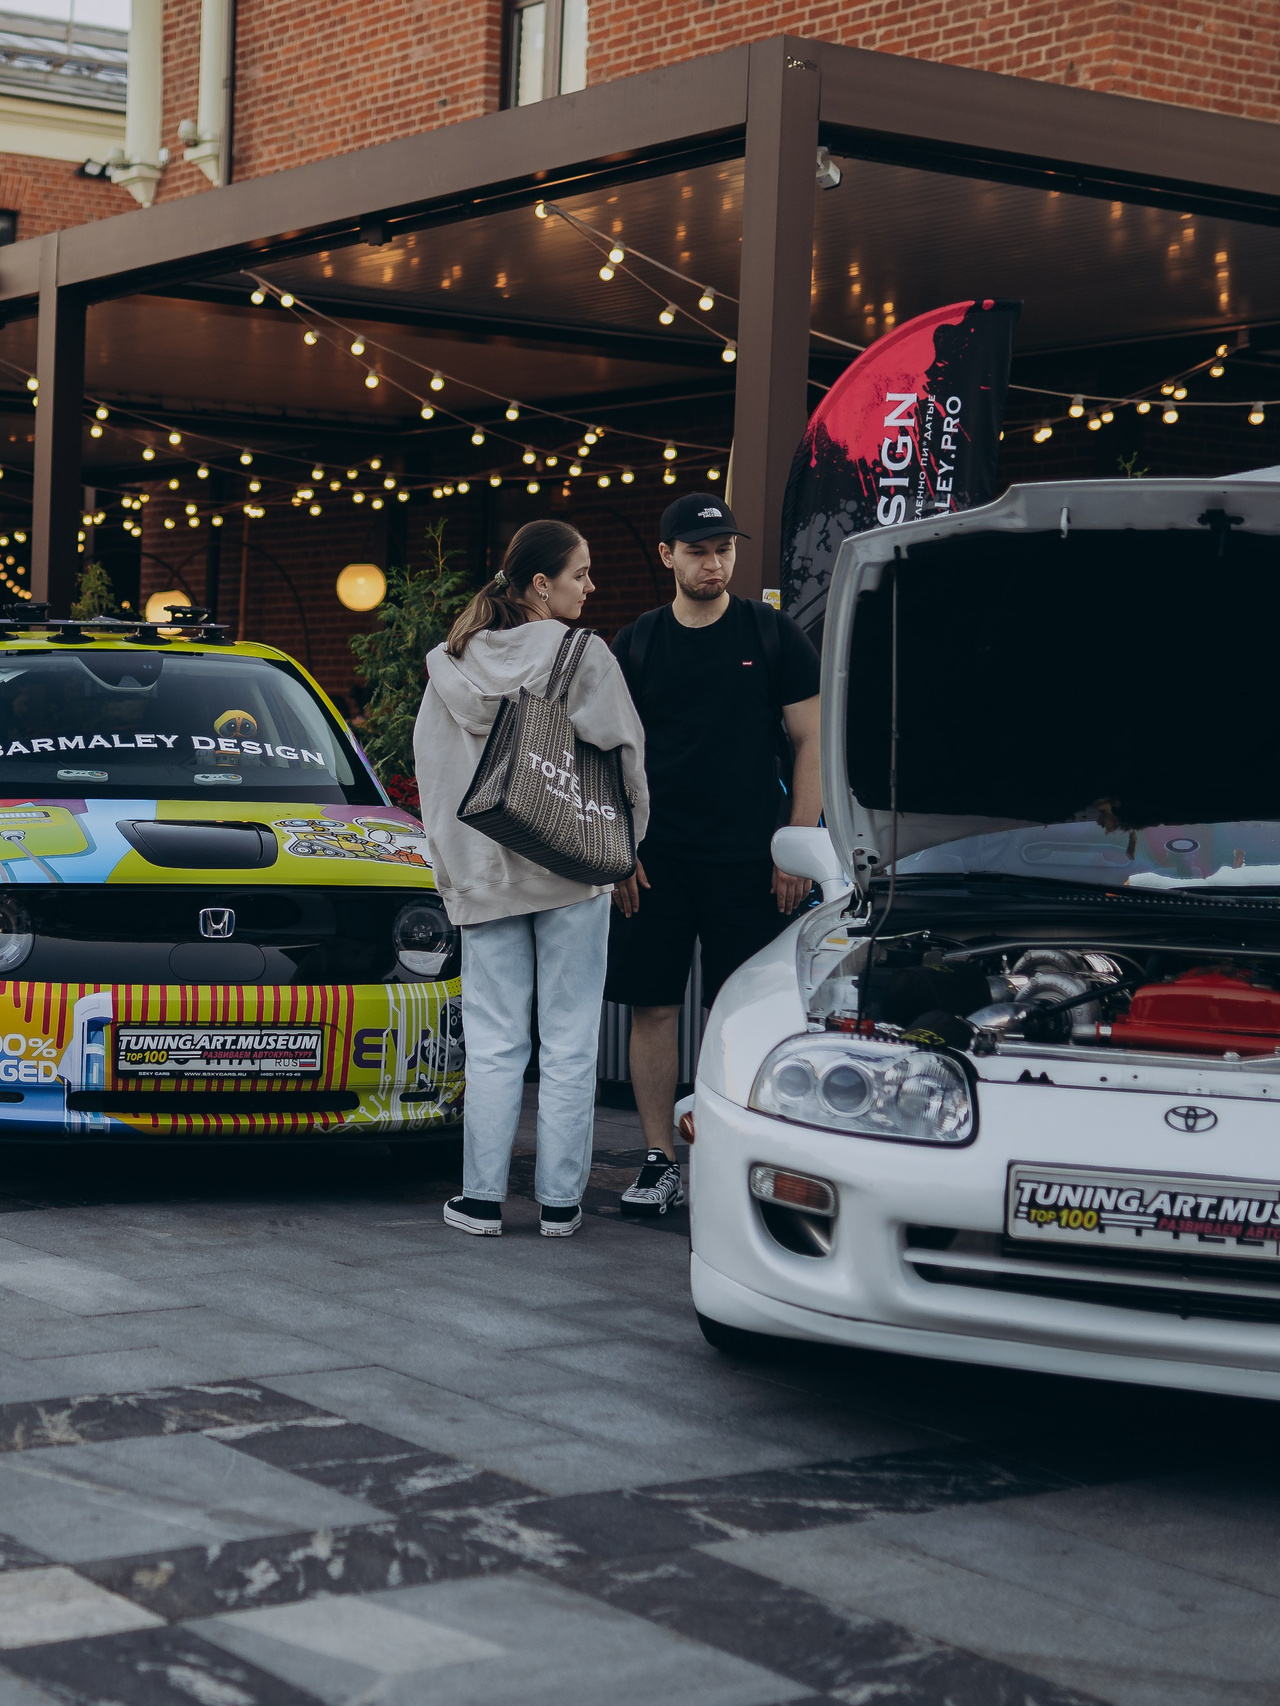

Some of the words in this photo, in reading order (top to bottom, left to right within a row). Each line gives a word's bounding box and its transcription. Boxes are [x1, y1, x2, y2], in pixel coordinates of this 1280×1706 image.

[877, 392, 918, 526] SIGN
[191, 735, 325, 766] DESIGN
[528, 752, 580, 790] TOTE
[120, 1035, 318, 1050] TUNING.ART.MUSEUM
[353, 1028, 431, 1069] EV
[143, 1051, 168, 1063] 100
[202, 1051, 251, 1059] РАЗВИВАЕМ
[252, 1051, 313, 1059] АВТОКУЛЬТУРУ
[275, 1059, 298, 1067] RUS
[1058, 1208, 1098, 1230] 100
[1158, 1217, 1243, 1237] РАЗВИВАЕМ
